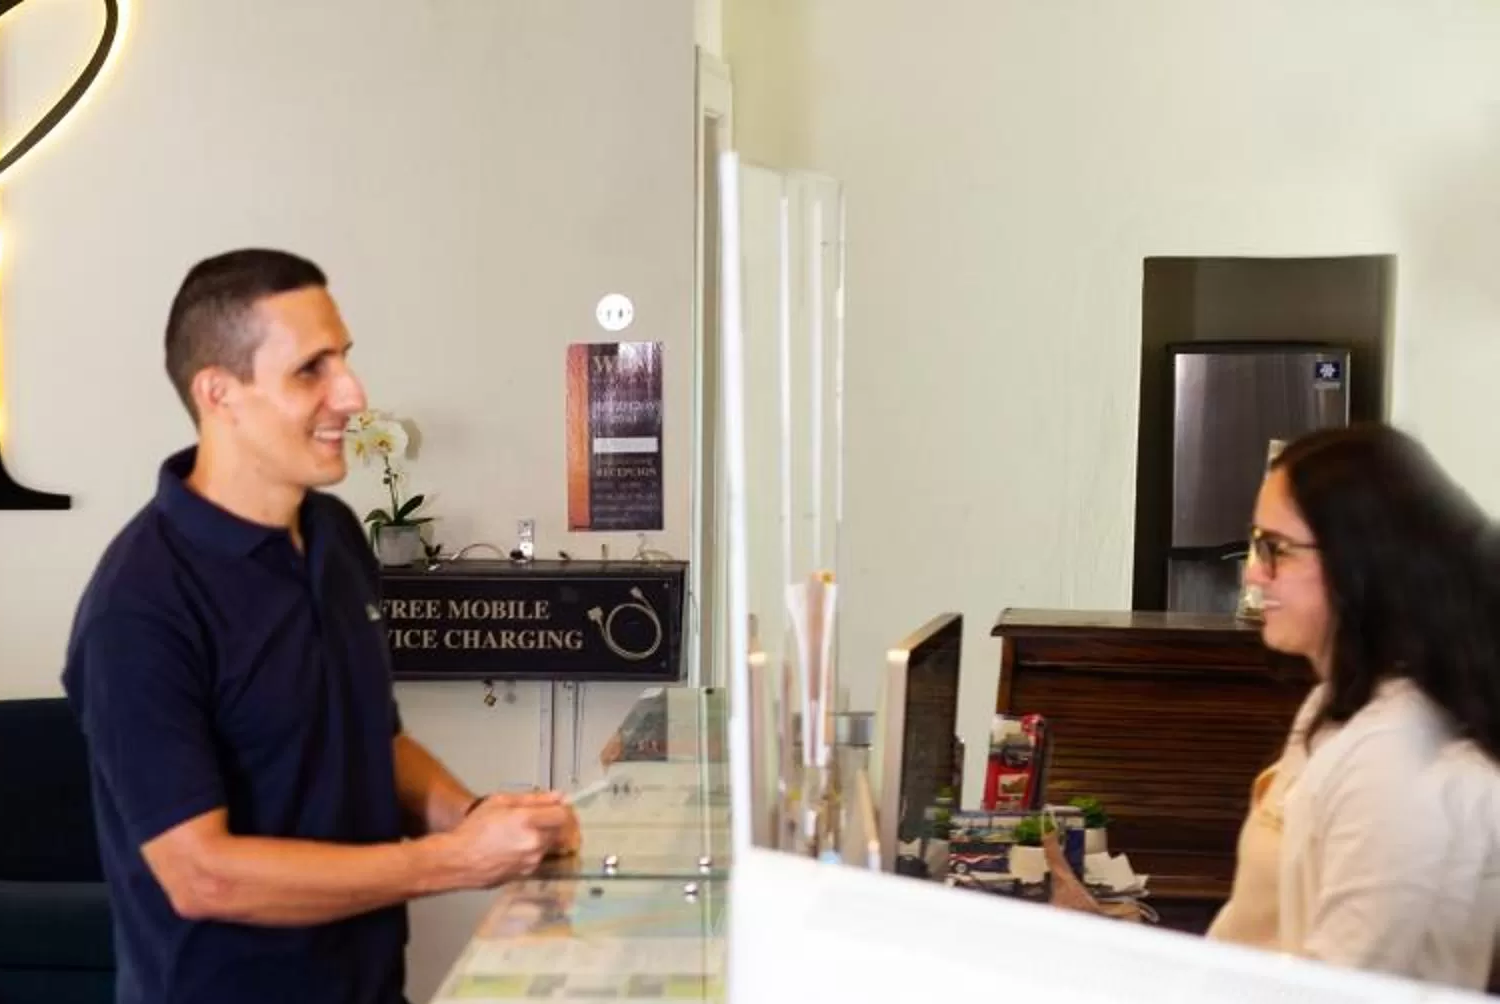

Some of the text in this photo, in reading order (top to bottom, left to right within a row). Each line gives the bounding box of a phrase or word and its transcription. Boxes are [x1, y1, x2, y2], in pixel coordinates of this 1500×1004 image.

[447, 599, 550, 620] MOBILE
[388, 629, 583, 649] ICE CHARGING
